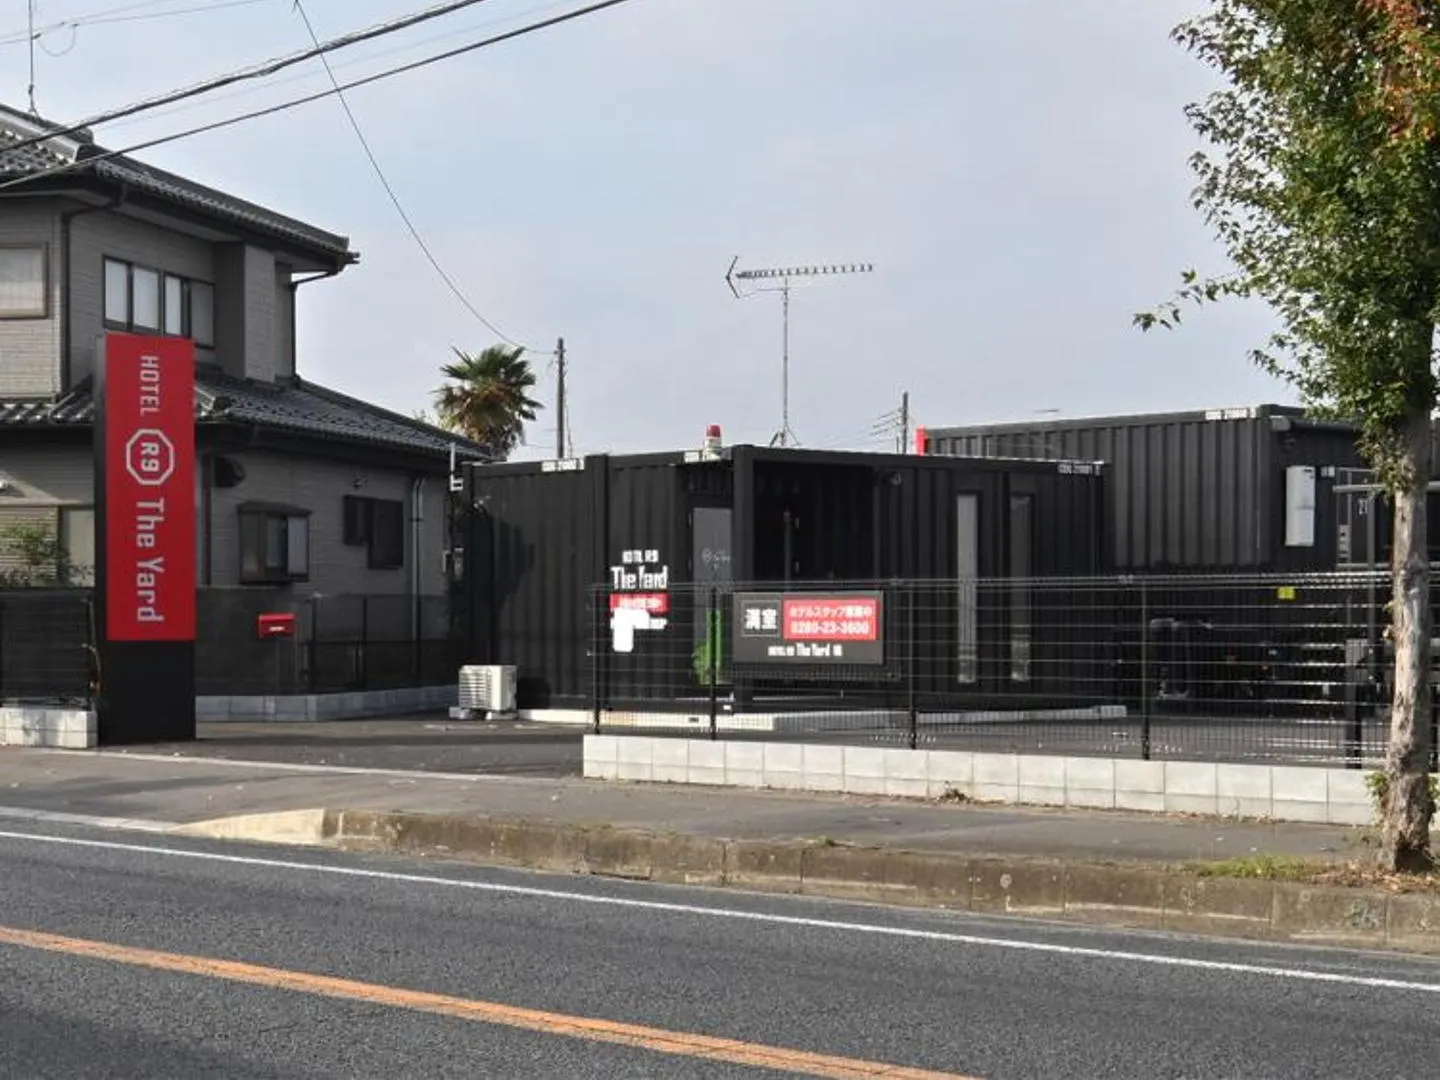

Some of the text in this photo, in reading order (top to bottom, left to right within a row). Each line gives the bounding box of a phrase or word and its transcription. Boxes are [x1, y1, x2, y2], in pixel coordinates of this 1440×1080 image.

[136, 355, 164, 622] HOTEL R9 The Yard
